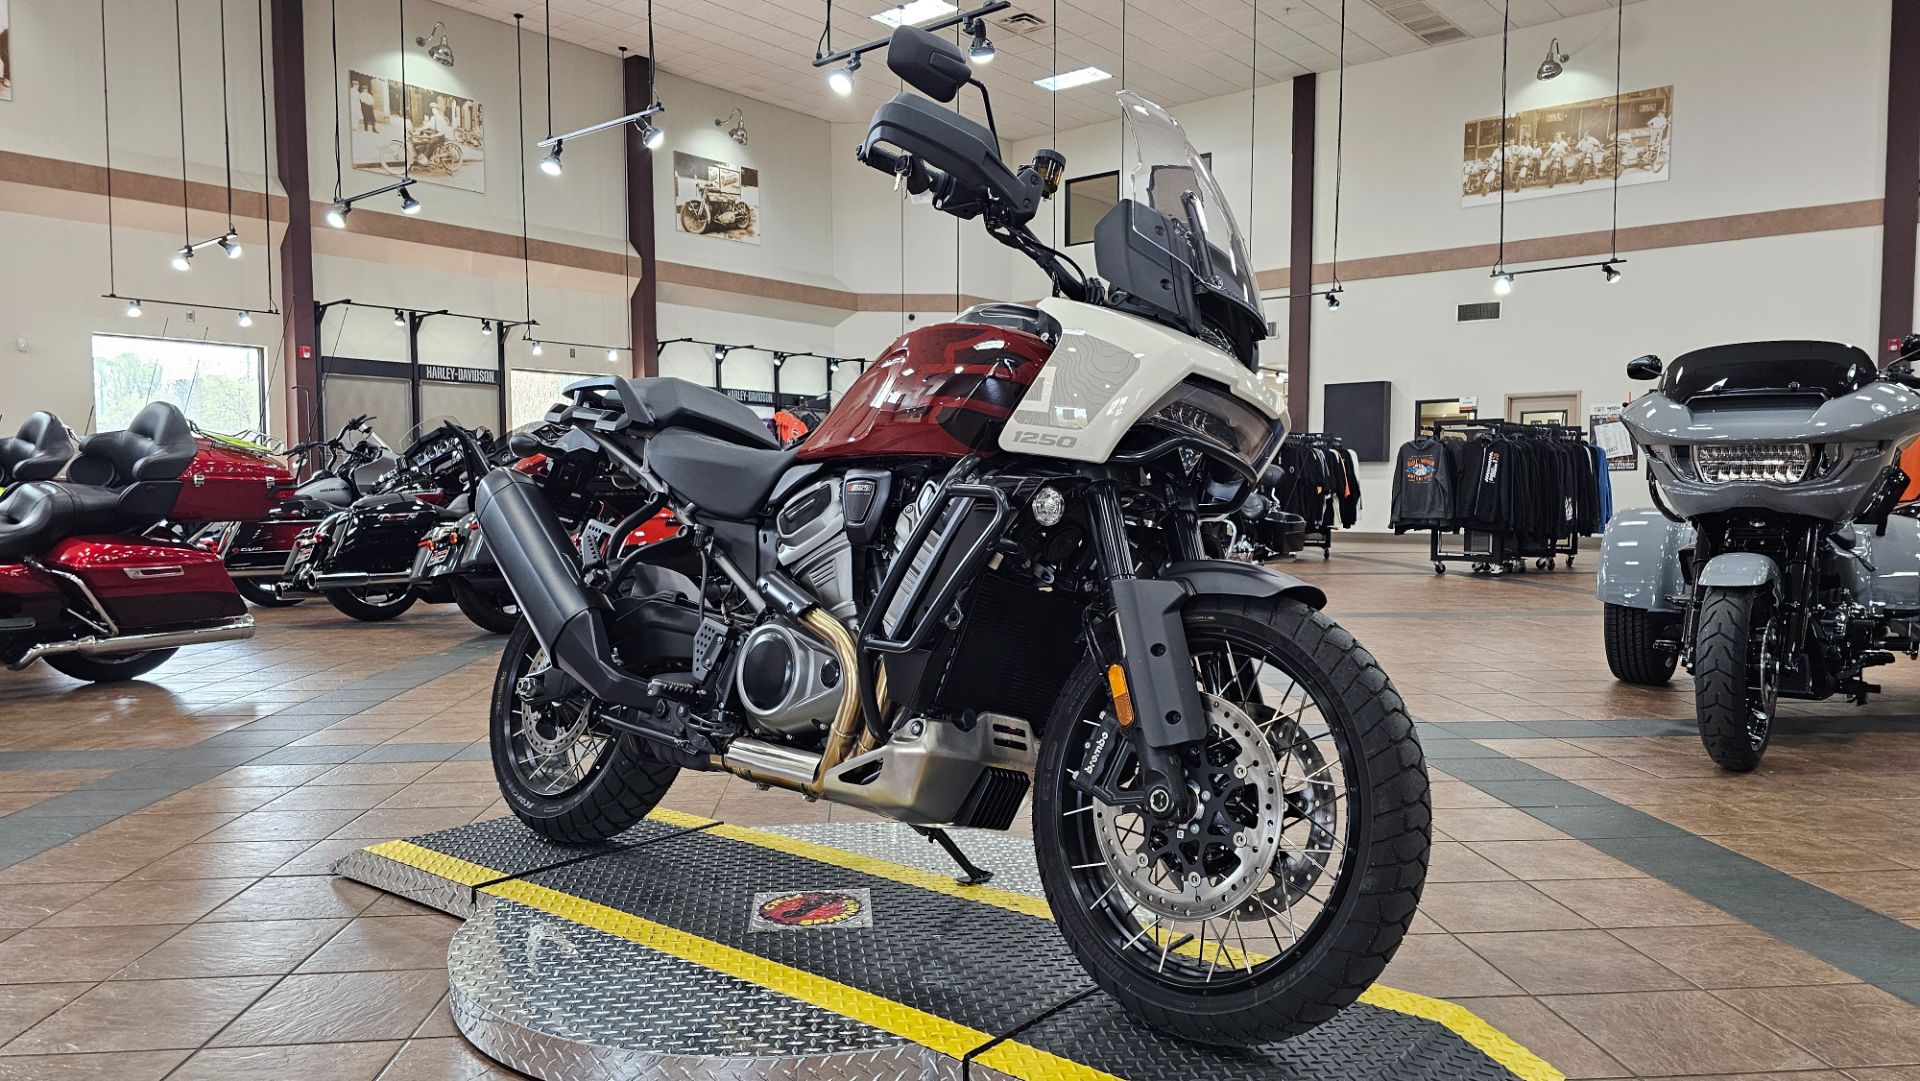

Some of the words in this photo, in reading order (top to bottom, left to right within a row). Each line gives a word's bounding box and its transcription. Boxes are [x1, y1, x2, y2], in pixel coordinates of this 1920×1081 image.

[426, 365, 496, 383] HARLEY-DAVIDSON
[1013, 430, 1078, 449] 1250
[1084, 731, 1109, 775] brembo
